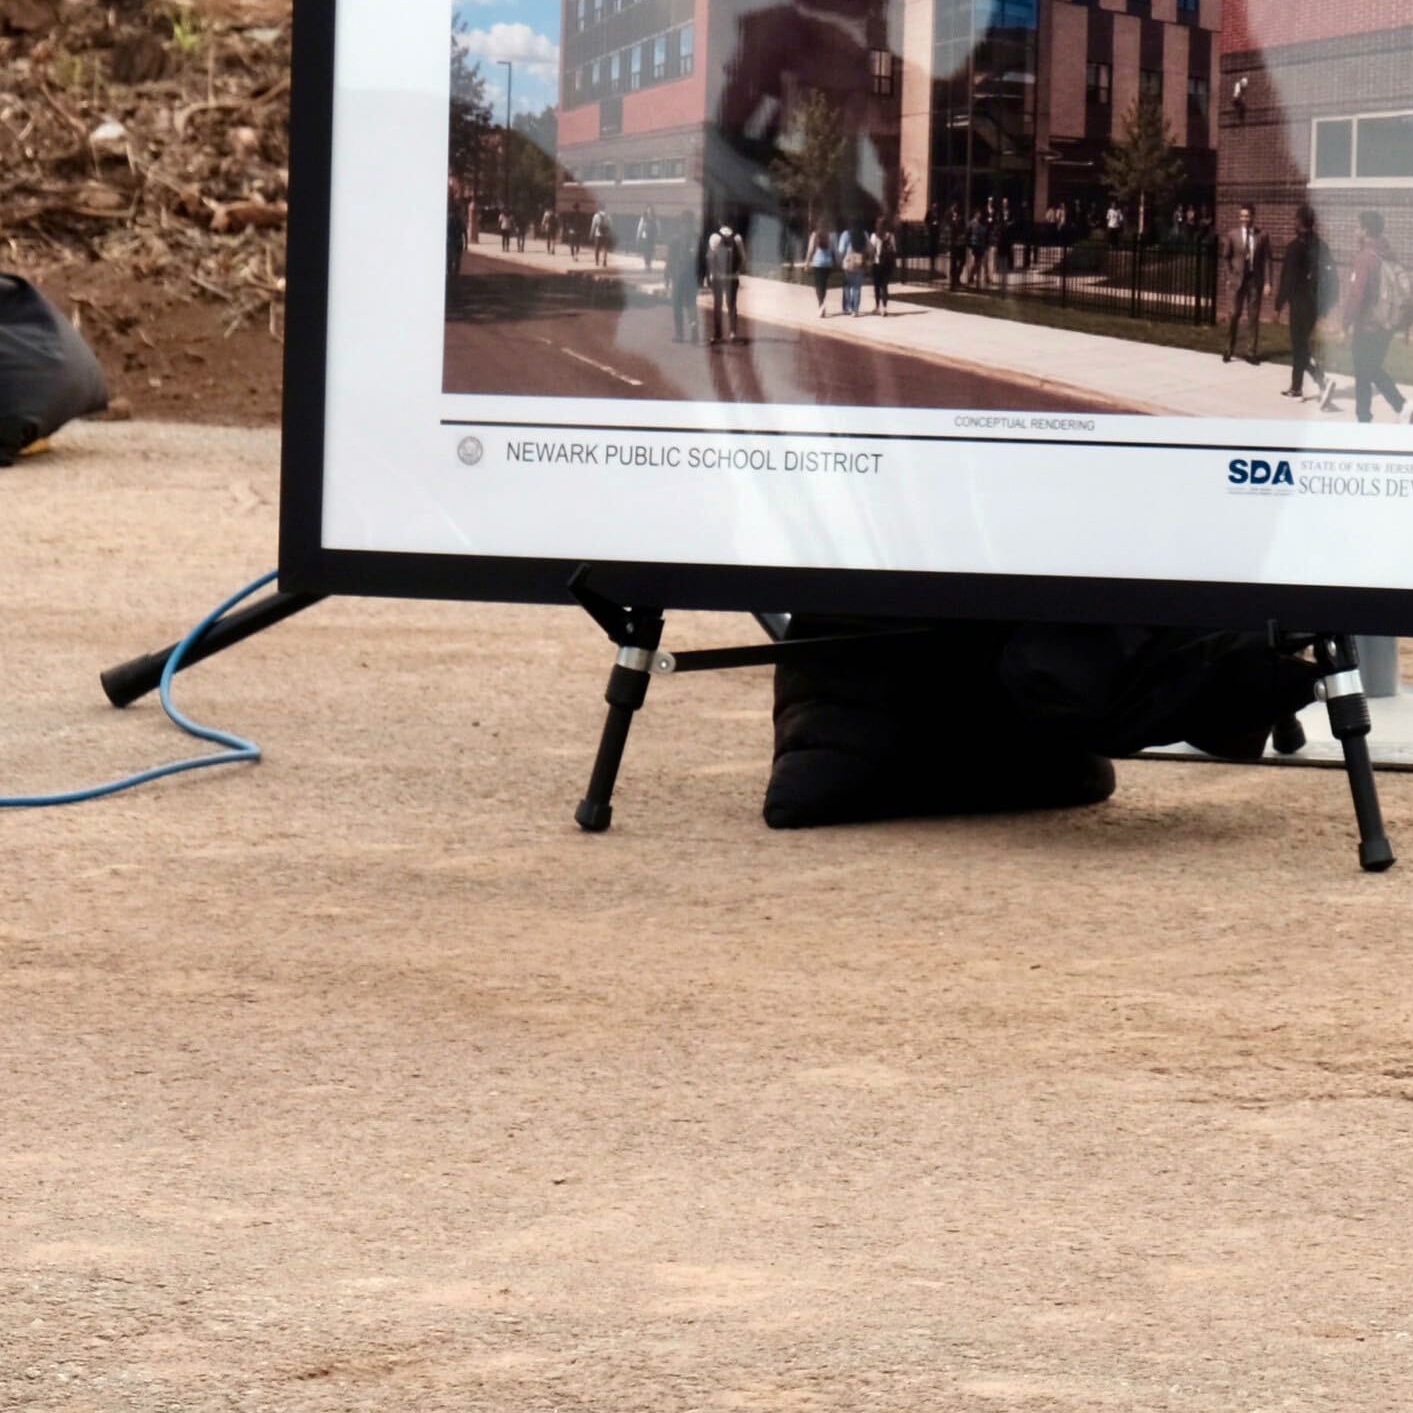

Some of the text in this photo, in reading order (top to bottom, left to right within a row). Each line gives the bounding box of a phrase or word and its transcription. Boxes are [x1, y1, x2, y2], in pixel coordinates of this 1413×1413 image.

[954, 415, 1095, 431] CONCEPTUAL RENDERING
[506, 442, 885, 474] NEWARK PUBLIC SCHOOL DISTRICT
[1300, 460, 1336, 472] STATE
[1228, 459, 1295, 485] SDA
[1298, 475, 1381, 497] SCHOOLS
